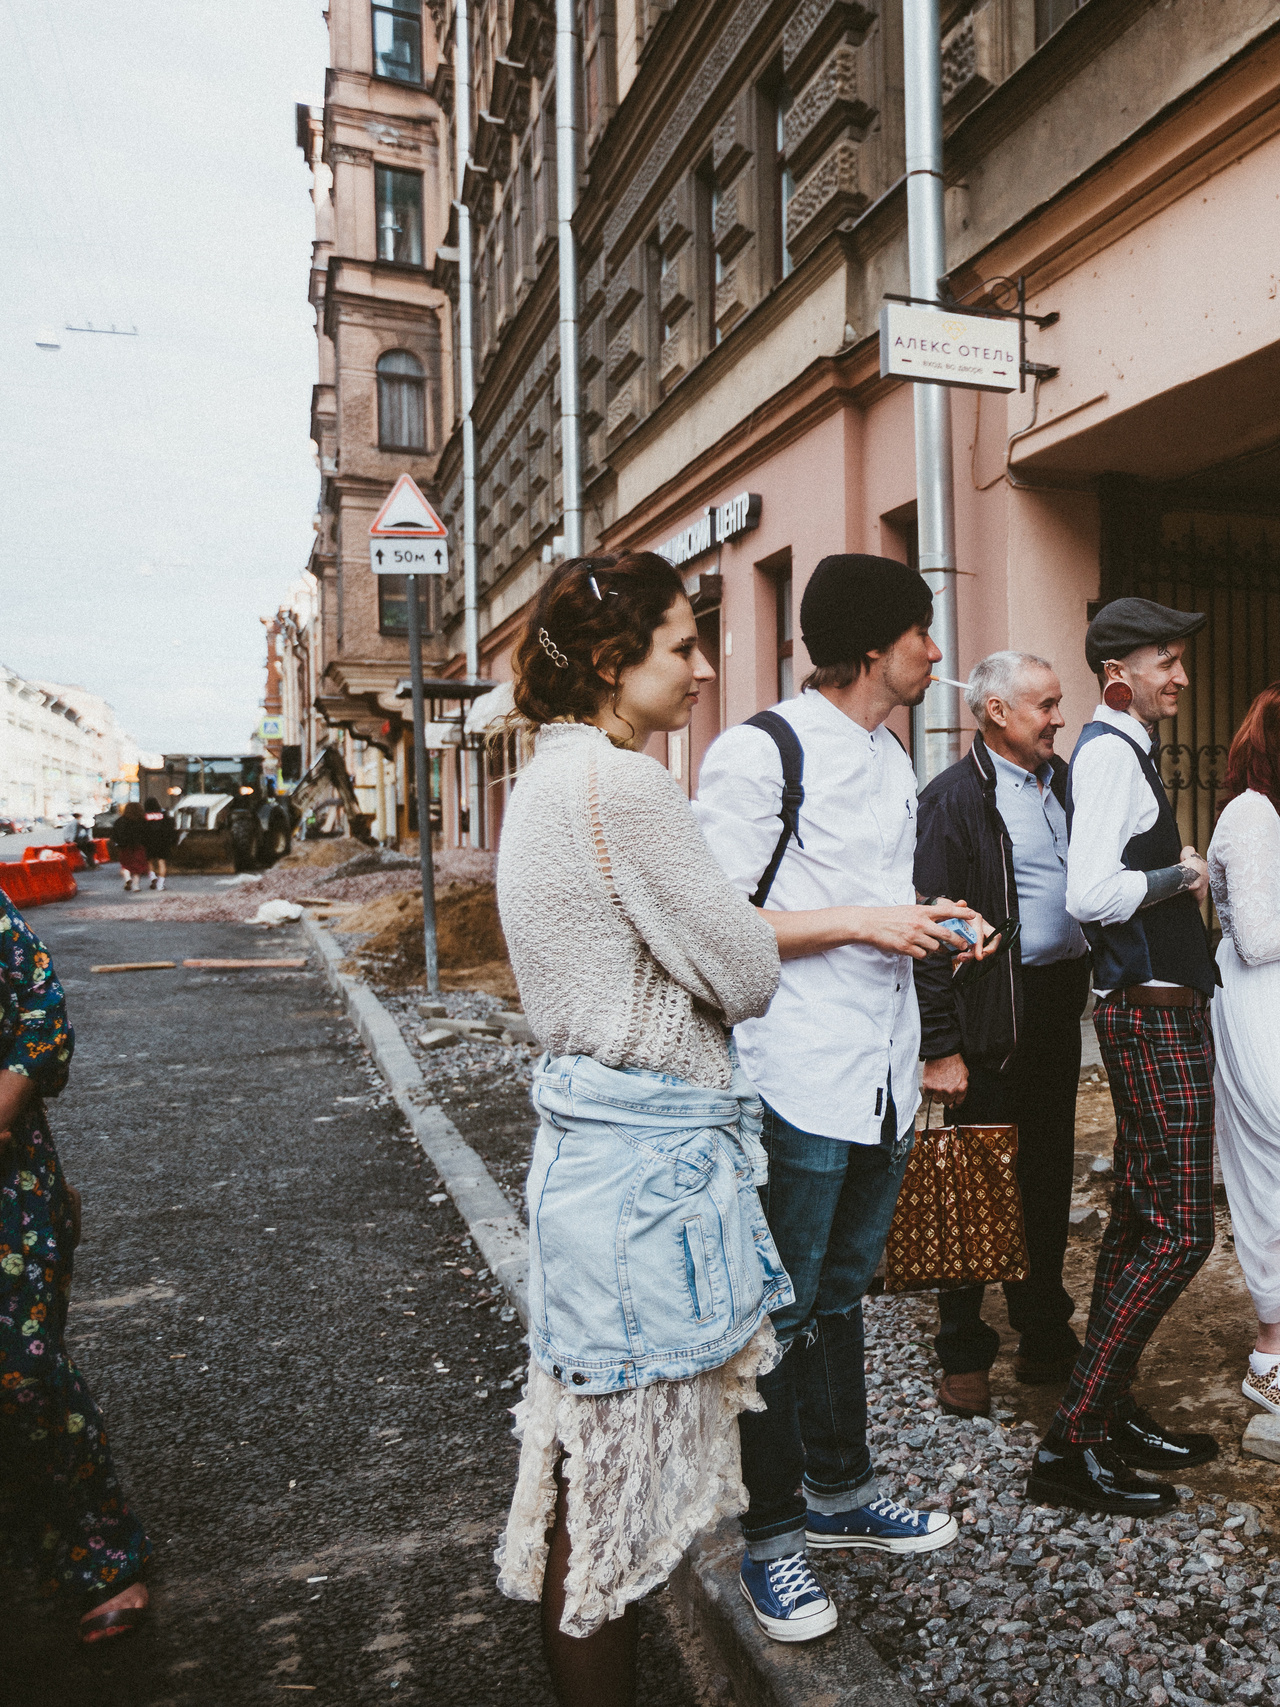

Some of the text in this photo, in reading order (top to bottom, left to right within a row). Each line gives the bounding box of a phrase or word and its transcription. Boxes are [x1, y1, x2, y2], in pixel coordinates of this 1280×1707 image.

[894, 336, 1014, 362] АЛЕКС ОТЕЛЬ
[715, 491, 750, 543] ЦЕНТР
